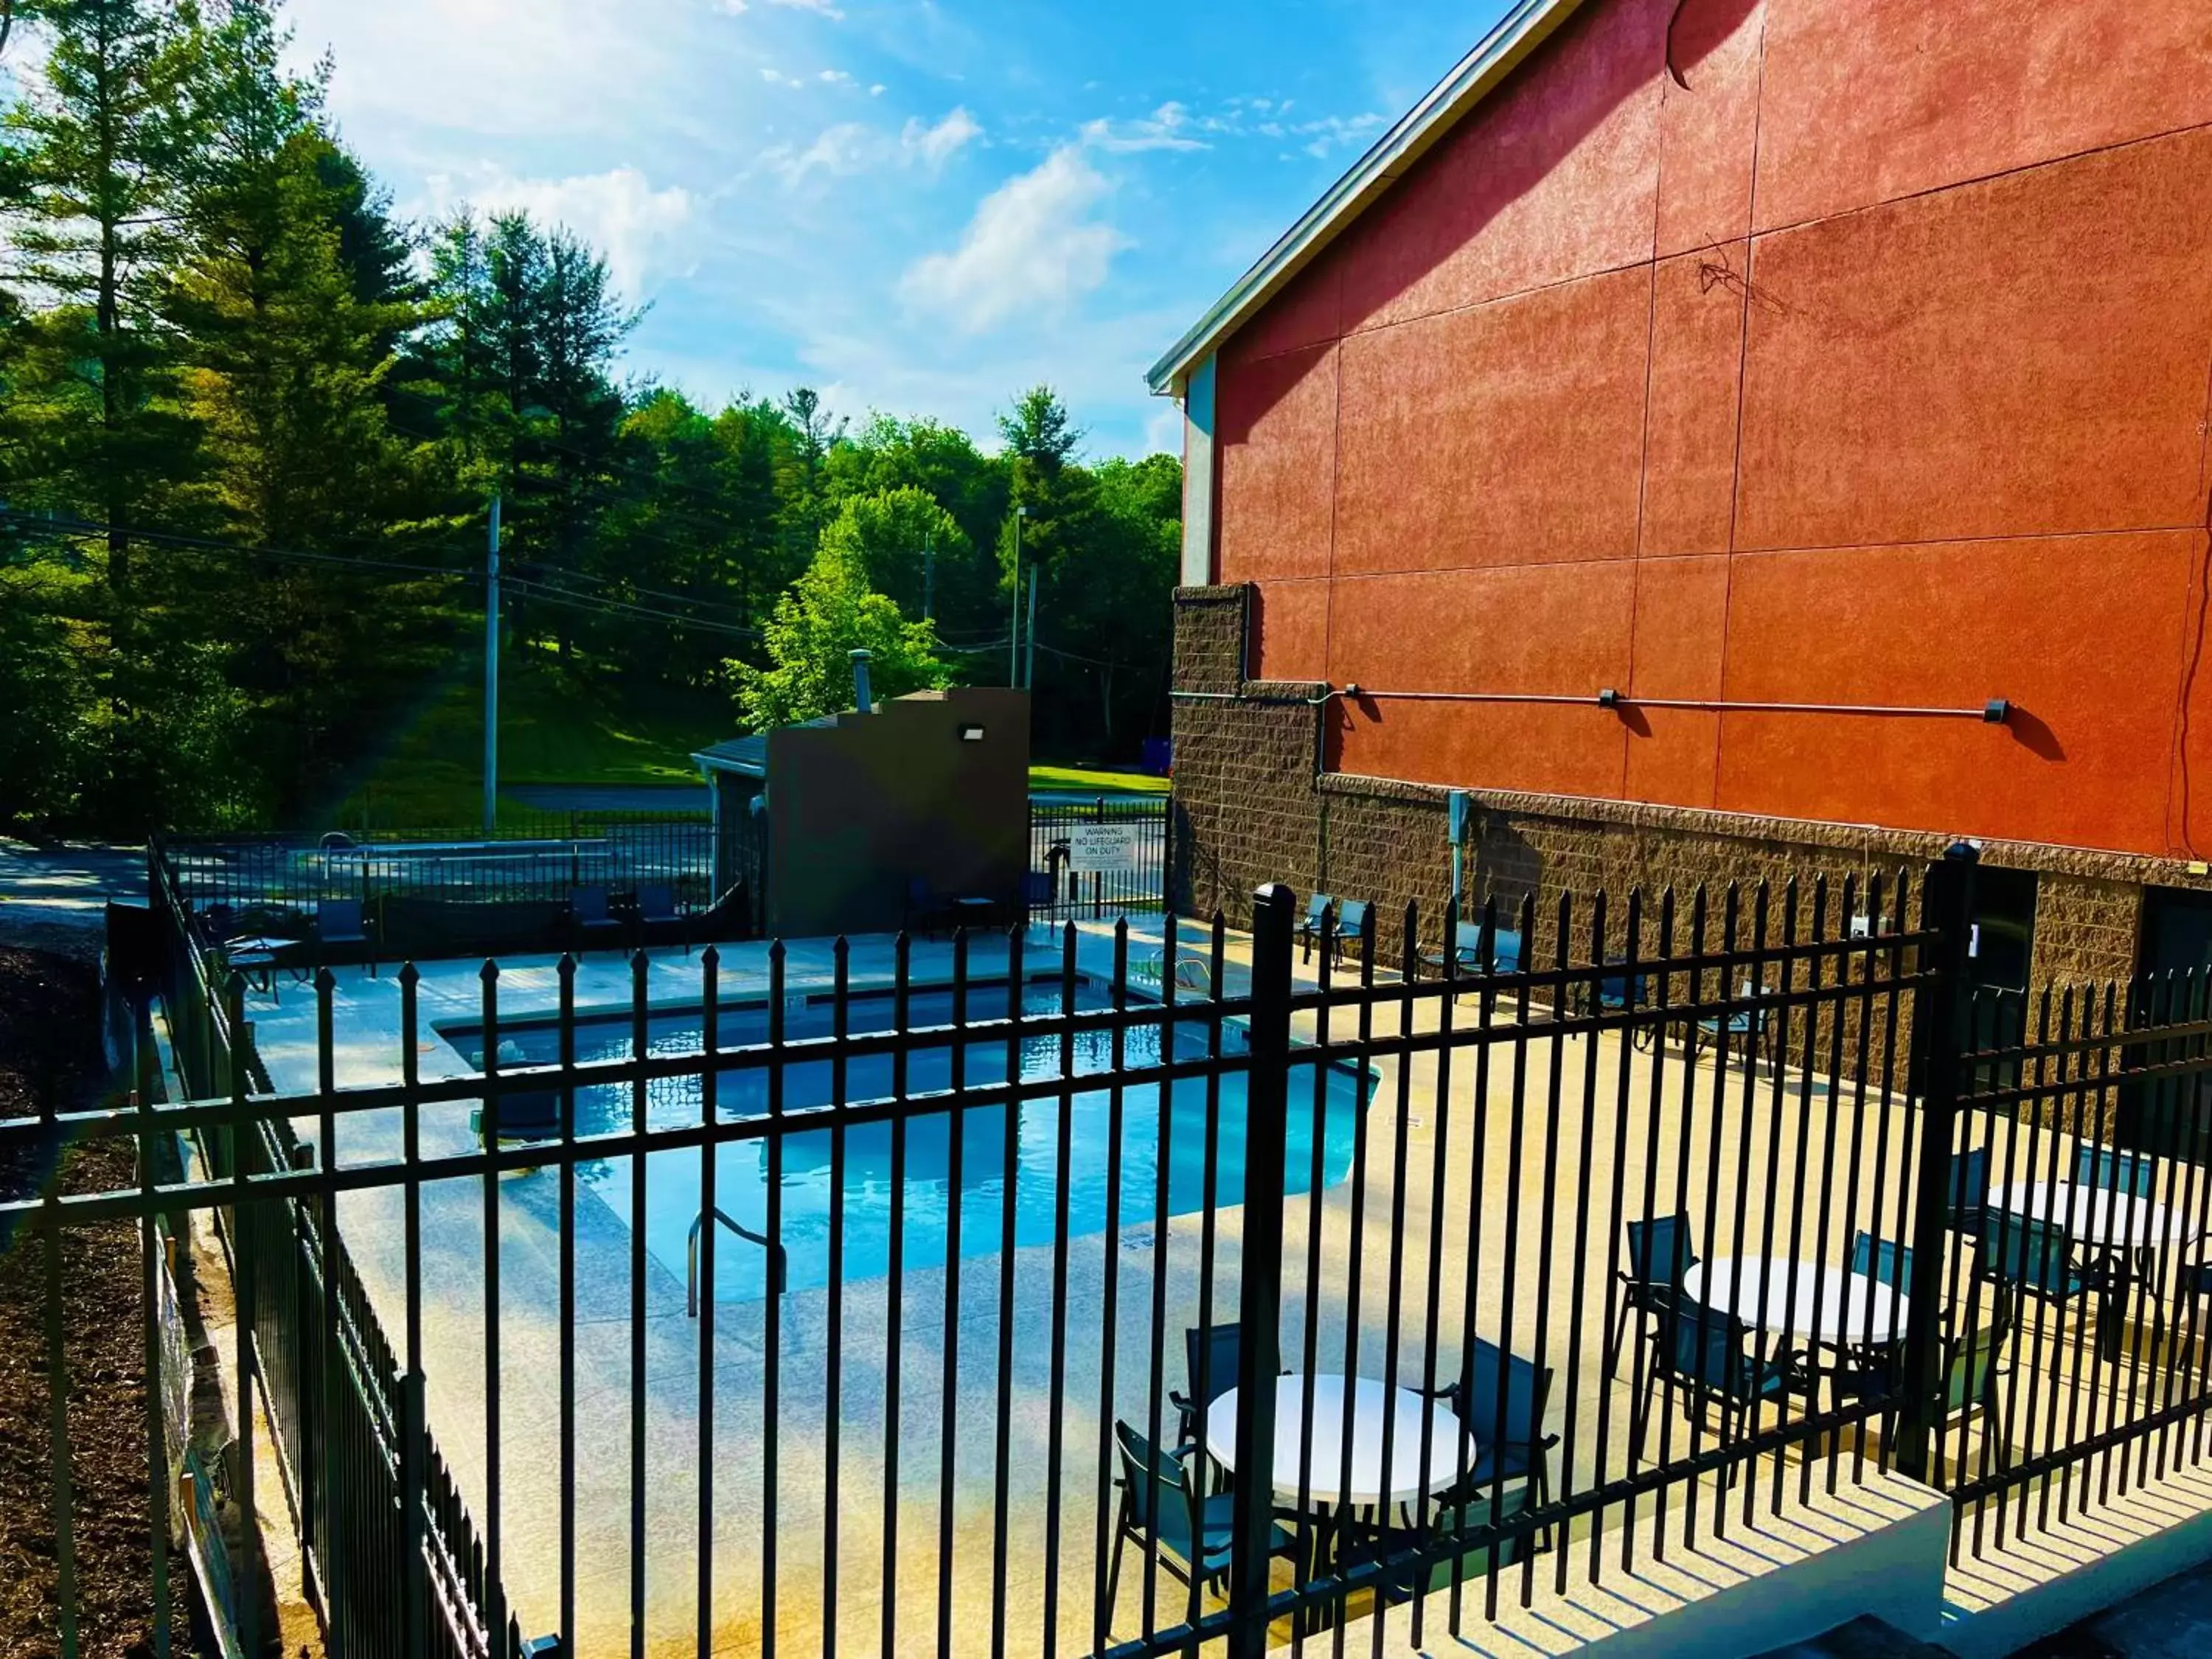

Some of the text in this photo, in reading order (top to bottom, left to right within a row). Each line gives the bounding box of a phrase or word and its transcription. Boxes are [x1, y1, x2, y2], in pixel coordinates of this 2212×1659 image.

[1085, 827, 1123, 835] WARNING
[1076, 836, 1131, 846] NO LIFEGUARD
[1085, 846, 1120, 855] ON DUTY
